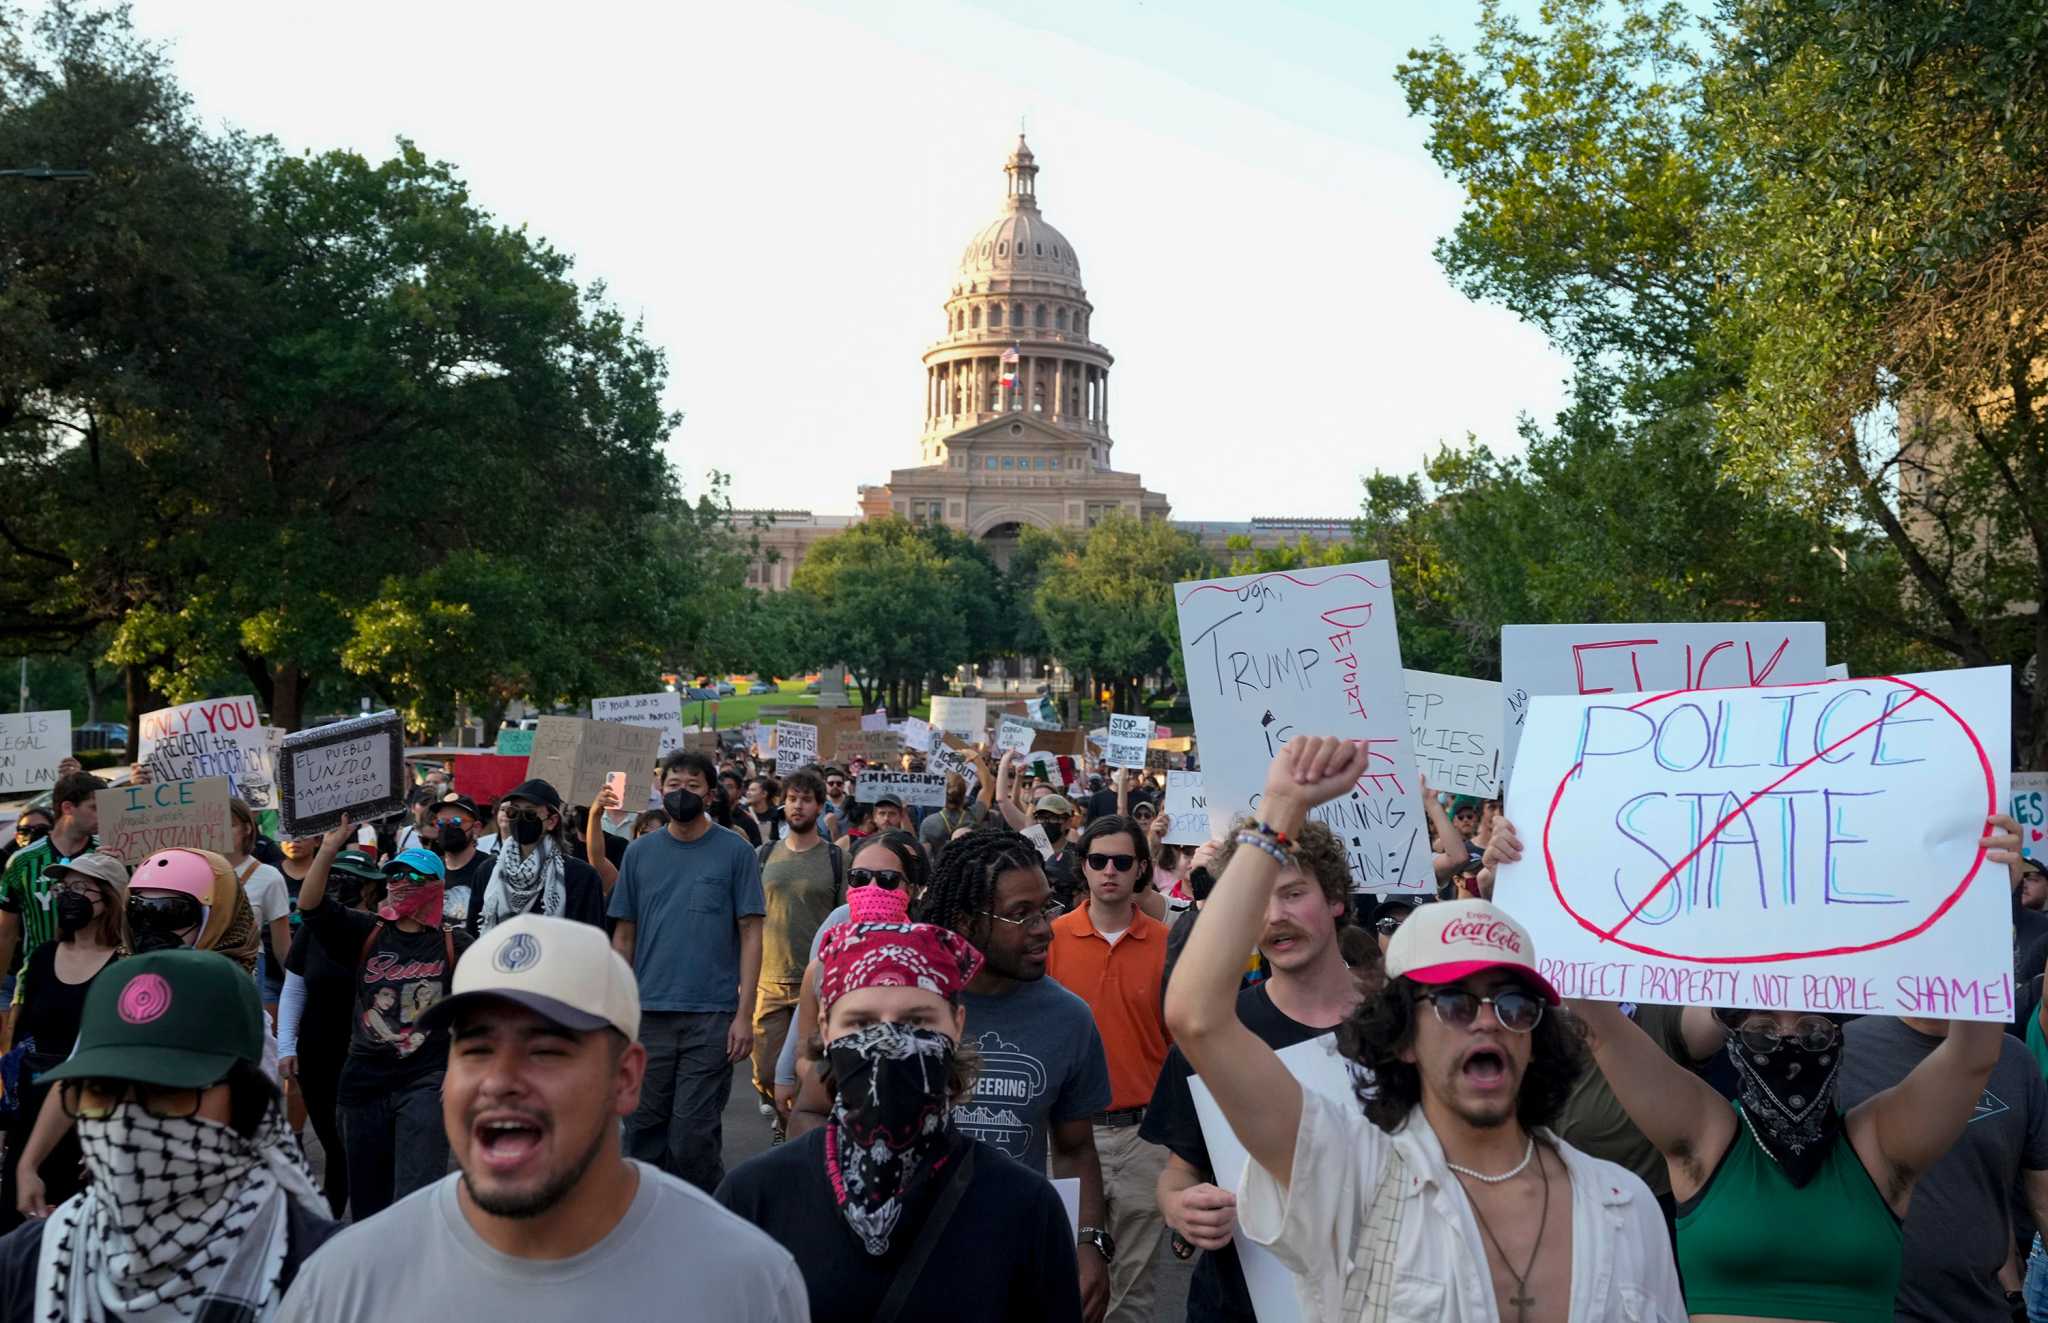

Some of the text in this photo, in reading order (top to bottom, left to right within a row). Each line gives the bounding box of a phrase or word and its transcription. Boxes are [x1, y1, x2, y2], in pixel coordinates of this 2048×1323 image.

[1192, 610, 1320, 702] TRUMP
[609, 699, 629, 712] YOUR
[1404, 690, 1444, 720] EP
[24, 716, 49, 734] IS
[143, 701, 255, 740] ONLY YOU
[1112, 718, 1137, 730] STOP
[1572, 689, 1935, 780] POLICE
[155, 730, 208, 760] PREVENT
[213, 736, 237, 750] the
[296, 740, 372, 769] EL PUEBLO
[778, 750, 800, 763] STOP
[1410, 727, 1485, 756] MLIES
[25, 768, 55, 784] LAN
[181, 763, 194, 780] of
[192, 747, 262, 778] DEMOCRACY
[308, 756, 372, 782] UNIDO
[860, 771, 946, 786] IMMIGRANTS
[1416, 748, 1499, 792] THER!
[297, 772, 377, 801] JAMAS SERA
[307, 783, 384, 814] VENCIDO
[2010, 791, 2044, 826] ES
[1615, 789, 1910, 925] STATE
[1753, 973, 1795, 1008] NOT
[1896, 973, 2013, 1018] SHAME!
